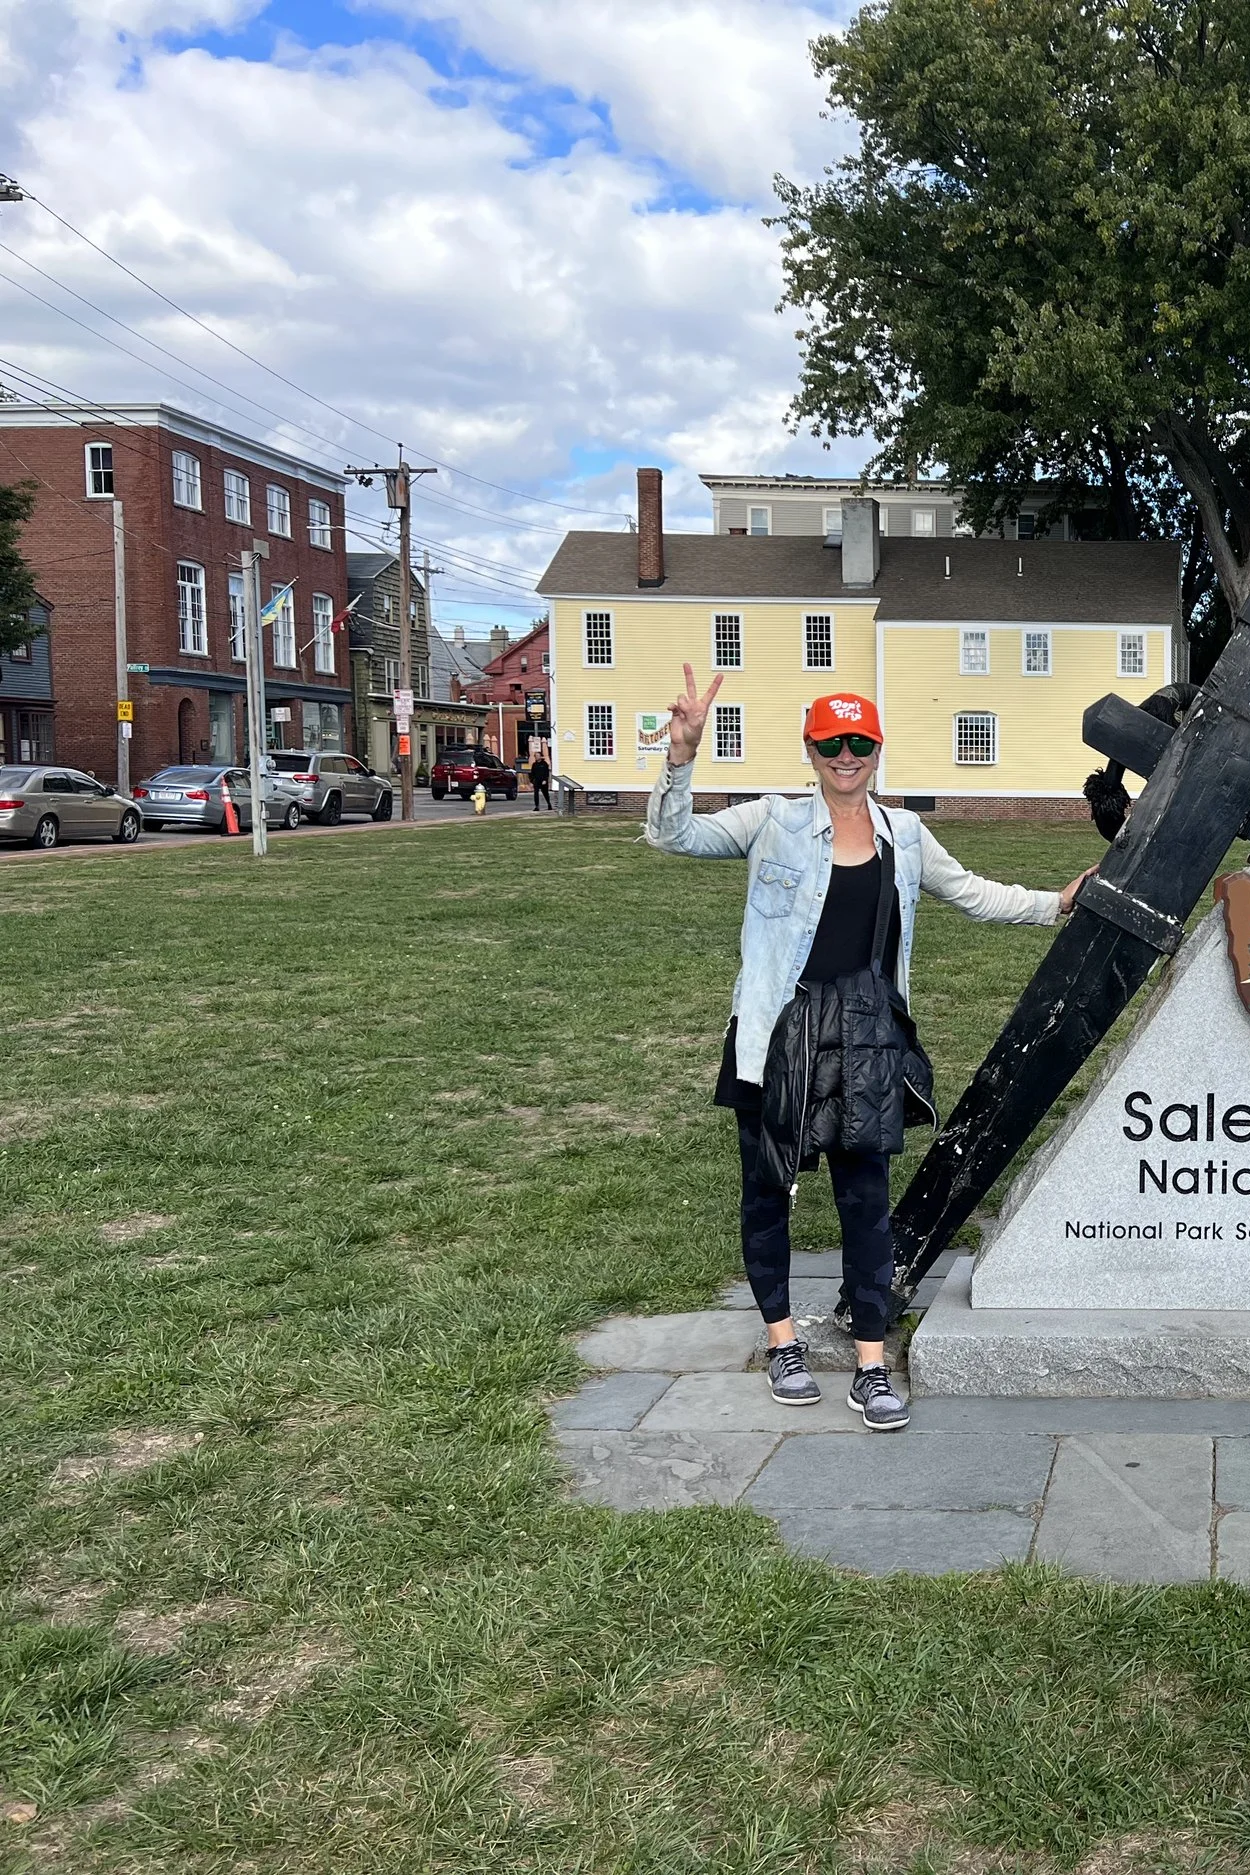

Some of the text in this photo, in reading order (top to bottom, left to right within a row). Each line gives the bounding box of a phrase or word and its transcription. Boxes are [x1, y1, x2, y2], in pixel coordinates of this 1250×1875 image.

[829, 700, 862, 713] Don't
[834, 708, 862, 721] Trip
[1065, 1220, 1163, 1240] National
[1175, 1221, 1224, 1240] Park
